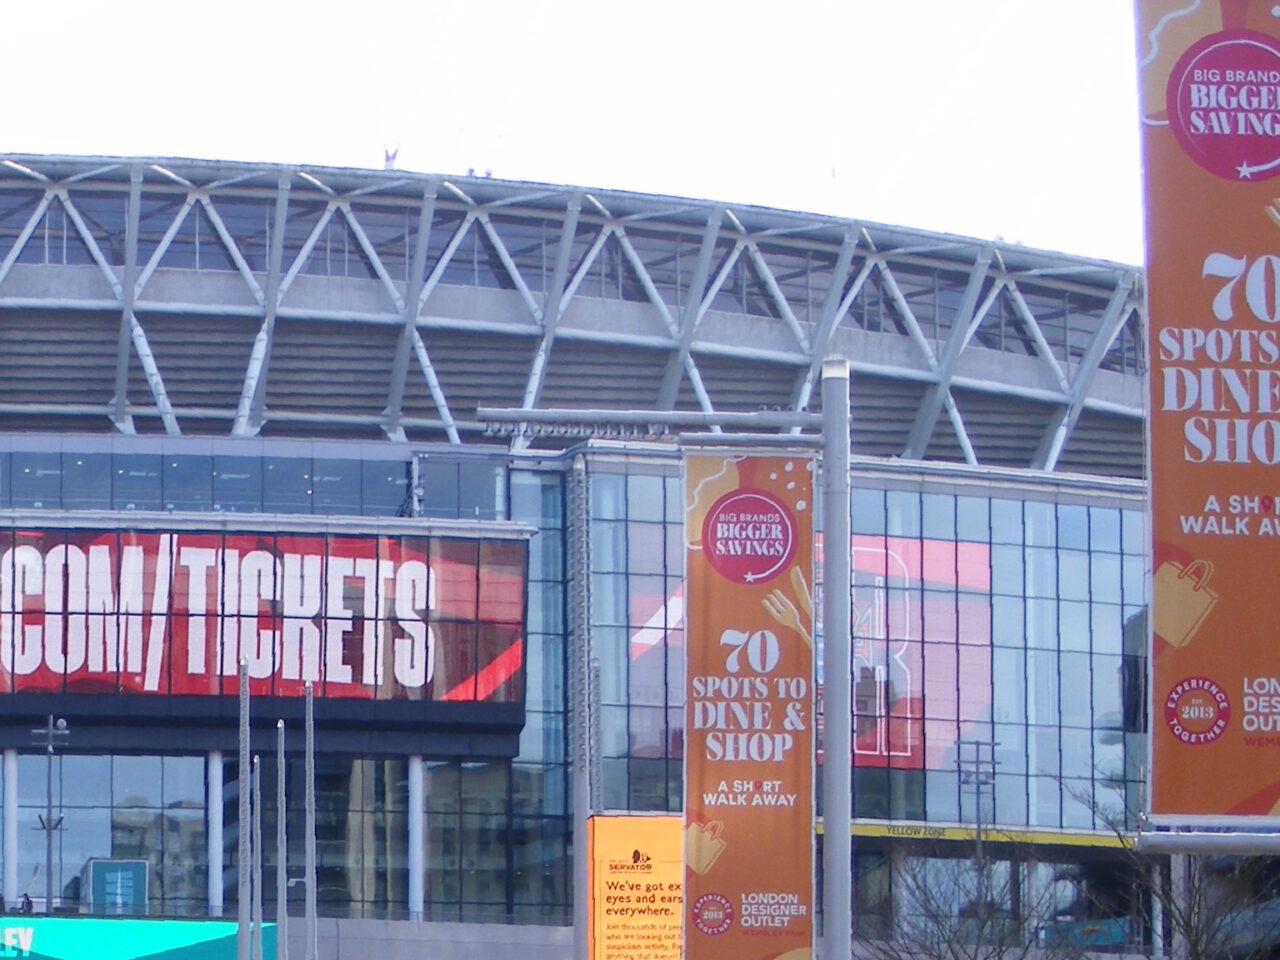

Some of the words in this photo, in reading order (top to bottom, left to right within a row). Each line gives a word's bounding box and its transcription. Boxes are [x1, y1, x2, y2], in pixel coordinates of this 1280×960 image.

[1193, 69, 1220, 82] BIG
[1159, 327, 1280, 364] SPOTS
[1204, 495, 1221, 513] A
[719, 513, 737, 522] BIG
[739, 513, 780, 522] BRANDS
[716, 523, 784, 540] BIGGER
[1180, 515, 1249, 535] WALK
[716, 540, 784, 556] SAVINGS
[720, 629, 780, 674] 70
[692, 676, 768, 699] SPOTS
[774, 677, 807, 700] TO
[1167, 678, 1228, 709] EXPERIENCE
[693, 701, 772, 730] DINE
[783, 702, 806, 731] &
[1182, 706, 1214, 719] 2013
[1169, 718, 1226, 743] TOGETHER
[705, 732, 793, 762] SHOP
[718, 780, 728, 792] A
[703, 793, 747, 806] WALK
[751, 793, 797, 806] AWAY
[886, 825, 921, 836] YELLOW
[606, 880, 641, 891] We've
[645, 883, 664, 893] got
[606, 896, 631, 905] eyes
[635, 893, 656, 904] and
[741, 893, 798, 904] LONDON
[606, 905, 674, 918] everywhere.
[741, 905, 806, 916] DESIGNER
[741, 916, 790, 927] OUTLET
[637, 933, 662, 941] looking
